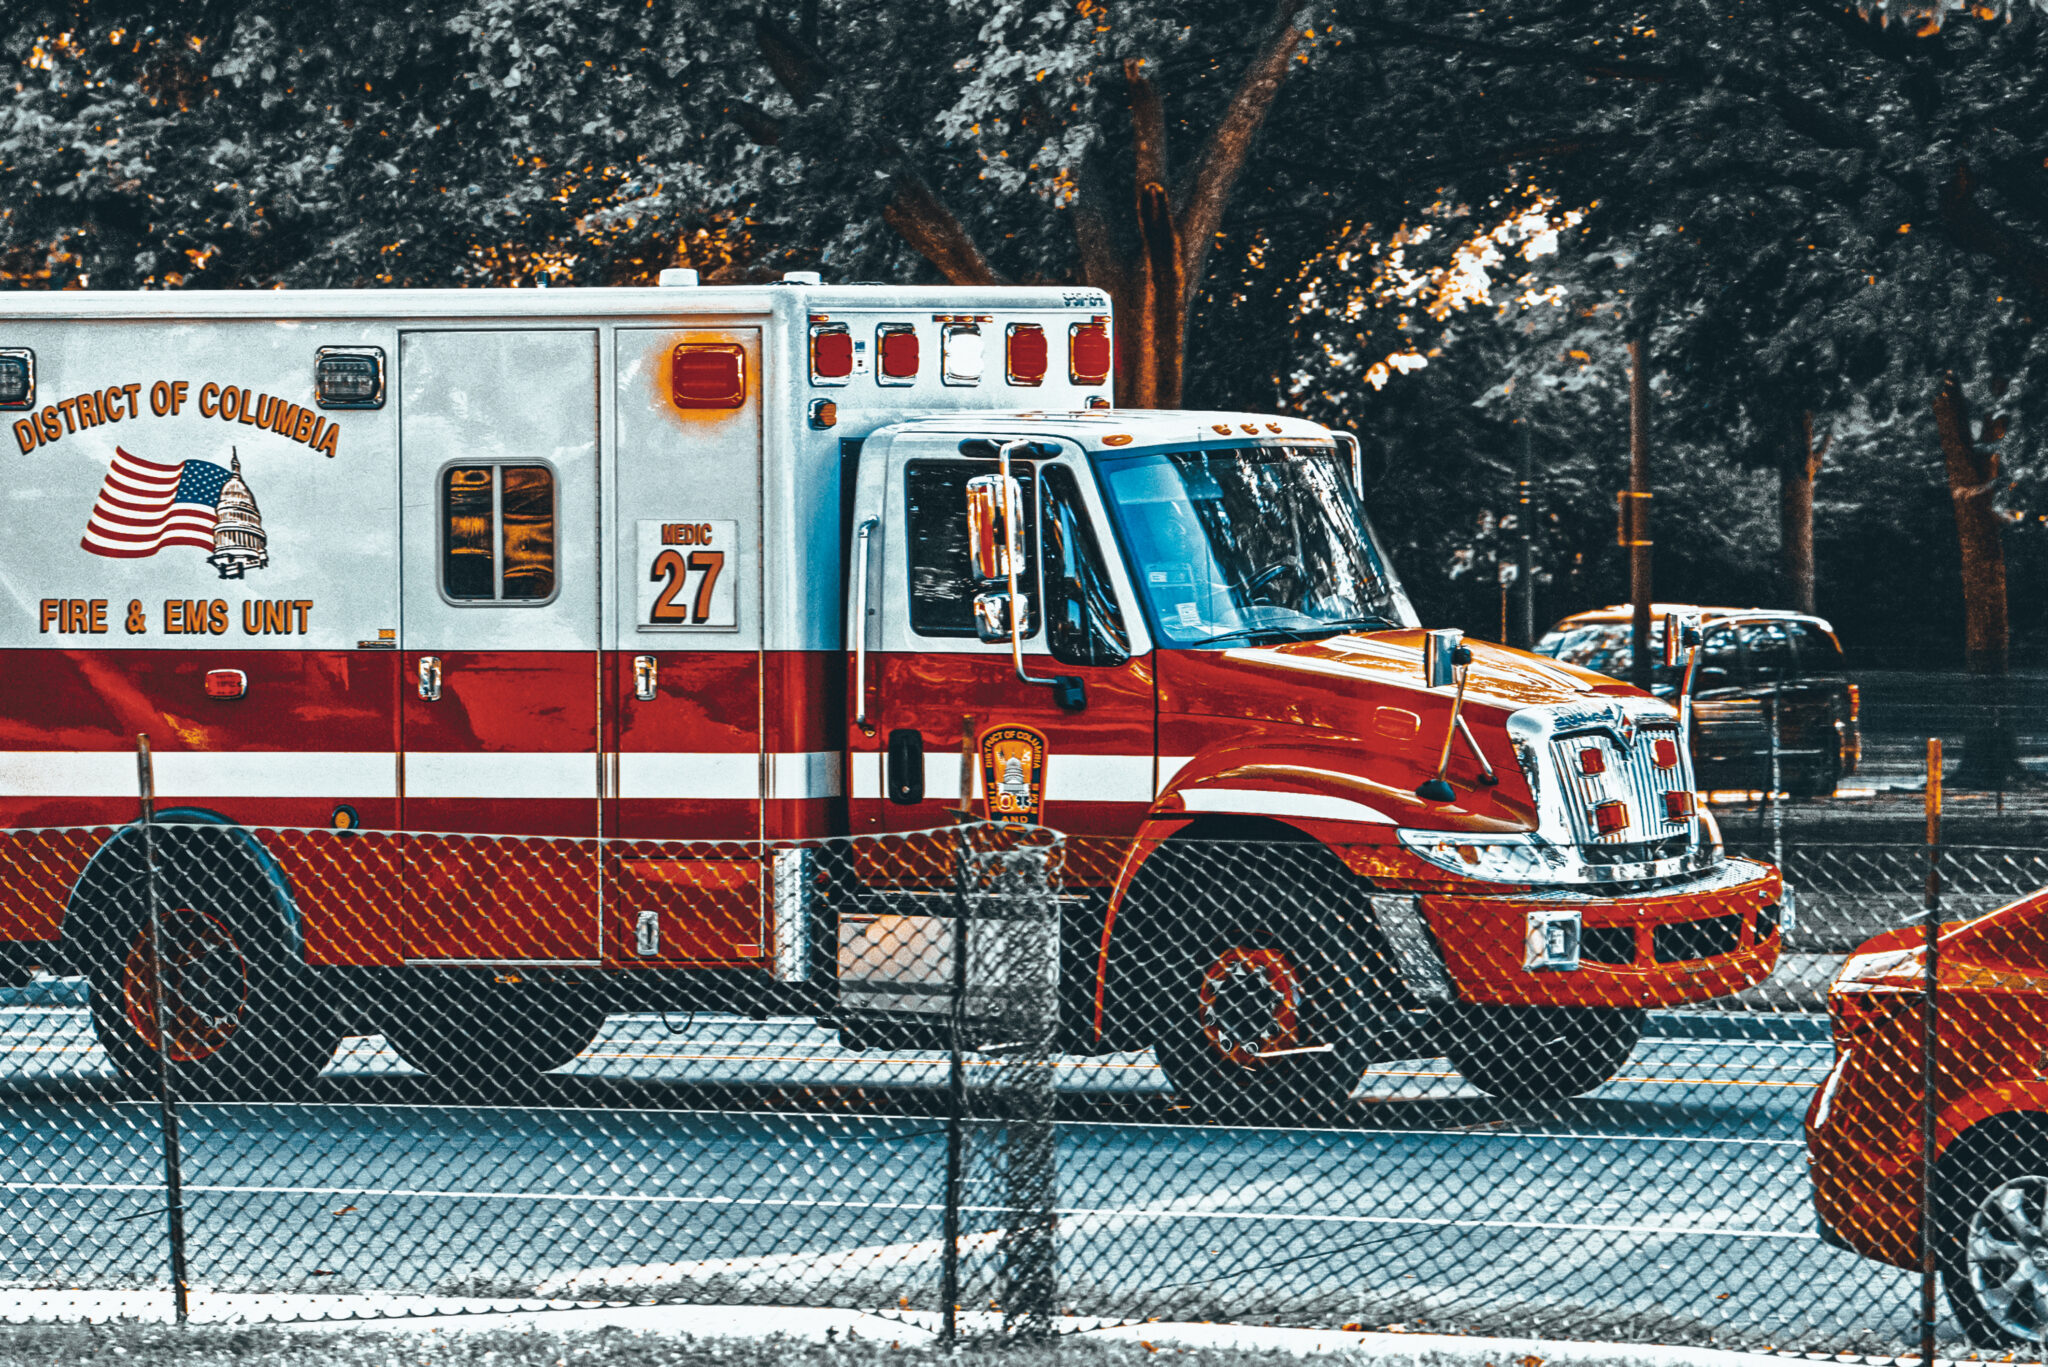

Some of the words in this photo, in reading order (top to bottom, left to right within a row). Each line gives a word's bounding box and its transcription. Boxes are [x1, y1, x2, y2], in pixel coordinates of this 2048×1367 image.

[13, 384, 142, 456] DISTRICT
[150, 380, 190, 416] OF
[199, 382, 341, 459] COLUMBIA
[661, 523, 713, 546] MEDIC
[649, 549, 725, 624] 27
[40, 599, 109, 634] FIRE
[125, 599, 147, 634] &
[164, 599, 230, 635] EMS
[243, 599, 314, 635] UNIT
[984, 732, 1003, 768] DISTRICT
[1004, 731, 1016, 739] OF
[1016, 731, 1042, 768] COLUMBIA
[1001, 815, 1029, 824] AND
